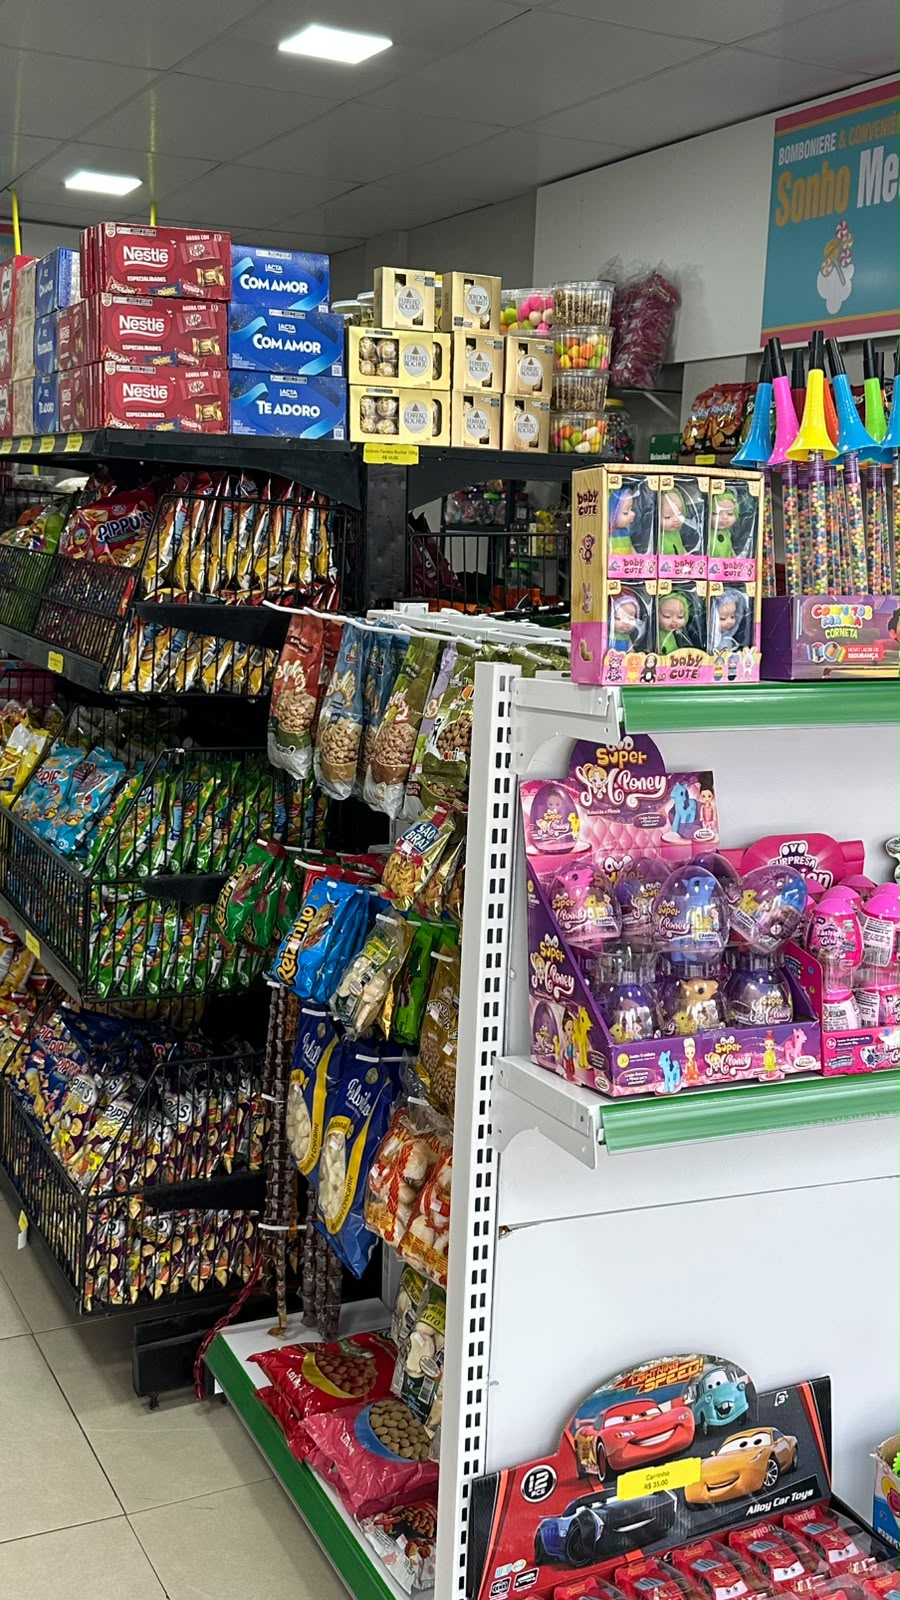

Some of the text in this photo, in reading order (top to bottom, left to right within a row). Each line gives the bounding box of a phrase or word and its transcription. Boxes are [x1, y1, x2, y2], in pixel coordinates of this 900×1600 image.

[778, 133, 837, 166] BOMBONIERE
[839, 130, 846, 148] &
[775, 145, 900, 227] Sonho Me
[265, 264, 283, 273] LACTA
[240, 274, 308, 294] COM AMOR
[278, 323, 297, 333] LACTA
[253, 333, 321, 354] COM AMOR
[279, 389, 298, 398] LACTA
[256, 400, 320, 417] TE ADORO
[577, 490, 598, 504] baby
[578, 505, 597, 516] CUTE
[623, 559, 644, 567] baby
[674, 560, 695, 568] baby
[723, 562, 744, 570] baby
[724, 569, 741, 577] CUTE
[825, 628, 858, 639] CORNETA
[670, 653, 703, 669] baby
[669, 666, 700, 680] CUTE
[595, 747, 647, 769] Super
[417, 823, 436, 840] SÃO
[405, 830, 430, 851] BRAZ
[782, 842, 806, 856] OVO
[276, 905, 317, 986] Reizinho
[631, 1361, 680, 1385] LIGHTNING
[643, 1357, 704, 1392] SPEED!
[528, 1470, 550, 1492] 12
[645, 1470, 670, 1481] Carrinho
[653, 1479, 669, 1488] 35,00
[531, 1488, 546, 1497] PCS
[746, 1486, 814, 1516] Alloy Car Toys
